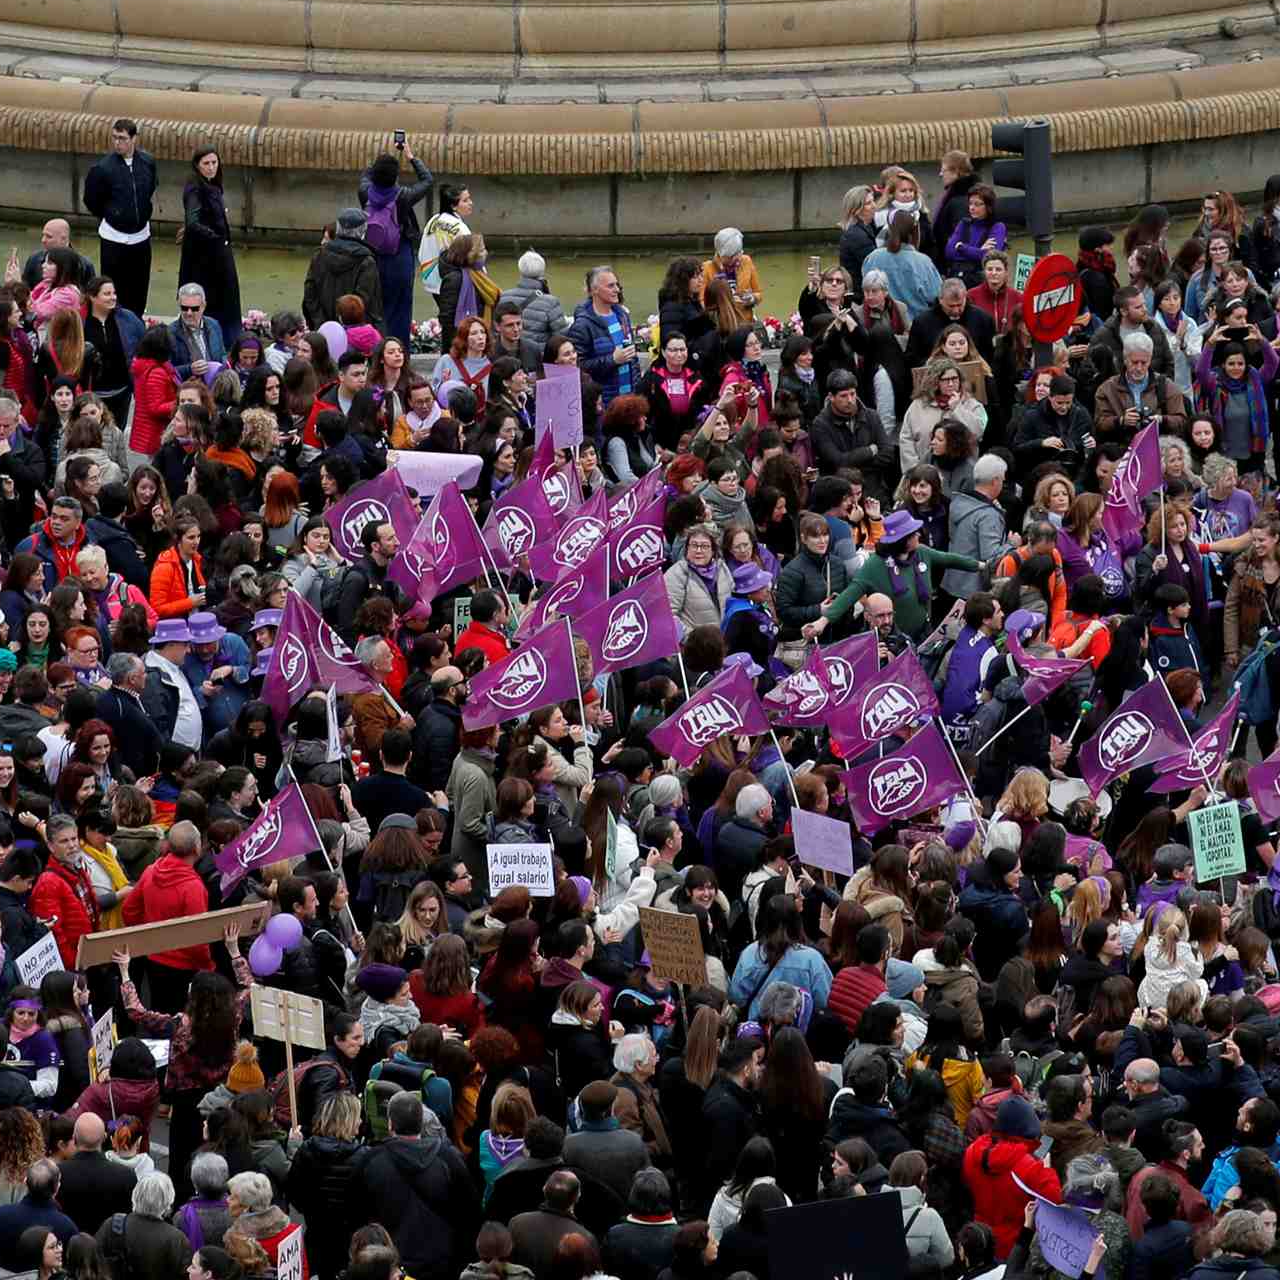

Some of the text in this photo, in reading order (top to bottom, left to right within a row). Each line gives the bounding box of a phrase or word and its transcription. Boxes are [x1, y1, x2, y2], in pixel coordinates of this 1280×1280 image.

[491, 852, 550, 868] ¡A igual trabajo,
[491, 871, 550, 887] igual salario!
[279, 1239, 299, 1266] AMA
